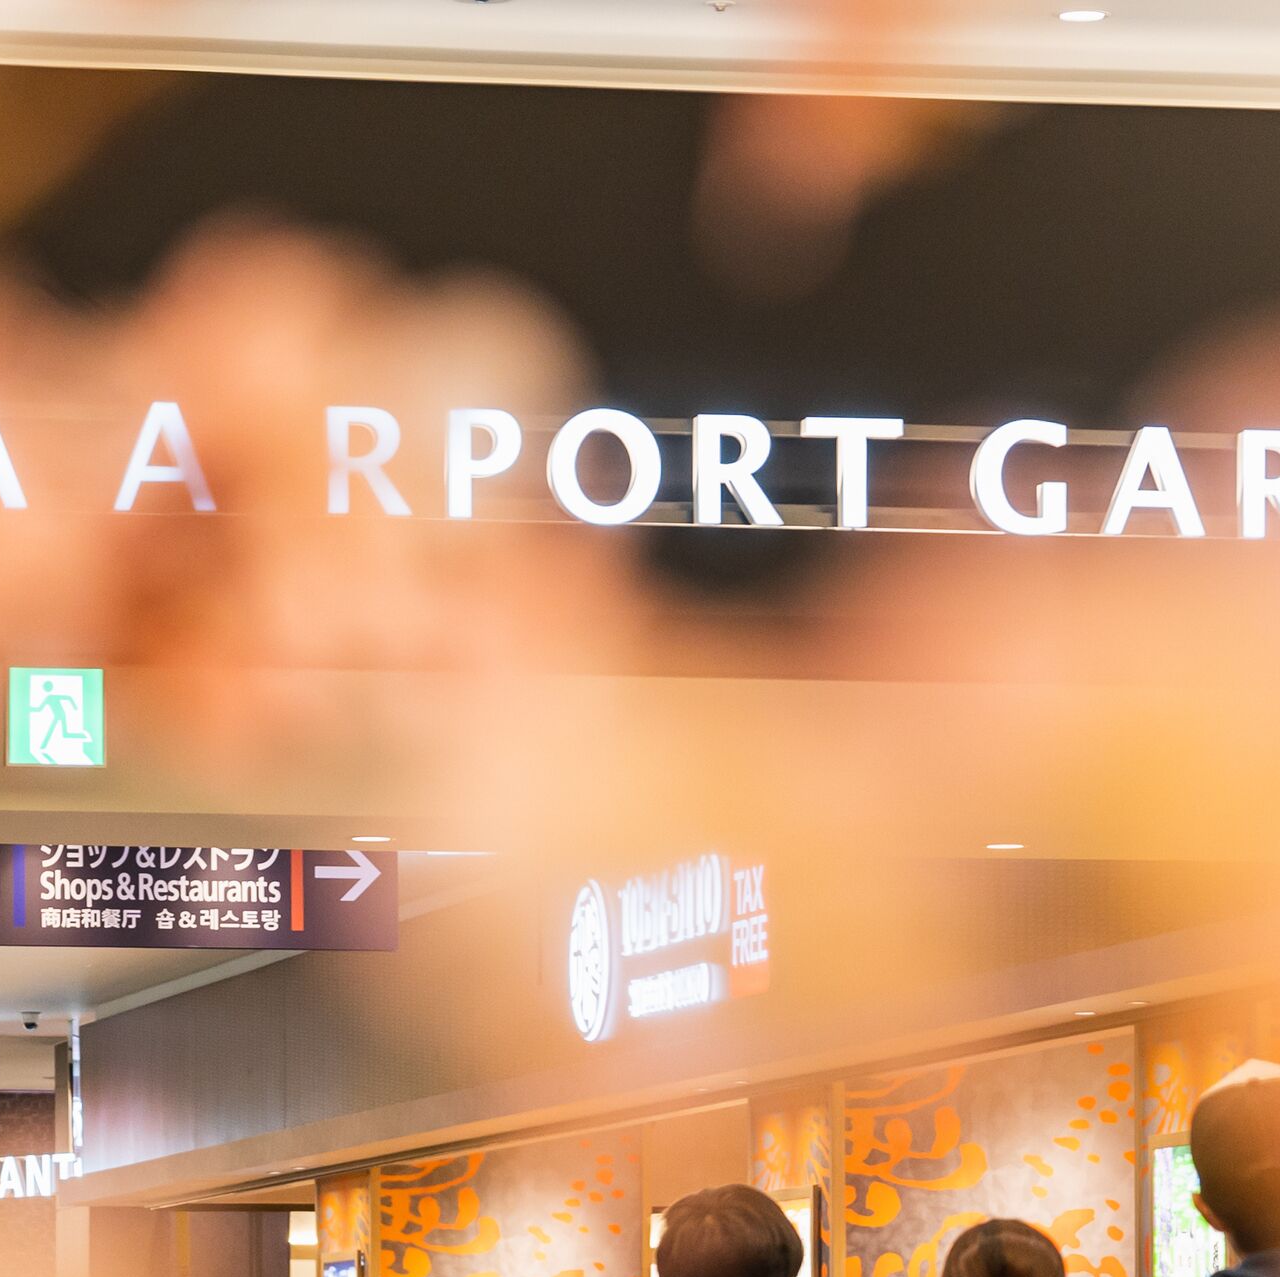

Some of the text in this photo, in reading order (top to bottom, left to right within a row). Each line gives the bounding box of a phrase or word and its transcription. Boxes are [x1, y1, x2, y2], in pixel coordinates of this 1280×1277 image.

[114, 401, 904, 529] ARPORT
[733, 864, 765, 915] TAX
[39, 907, 142, 929] 商店和餐厅
[732, 914, 769, 967] FREE
